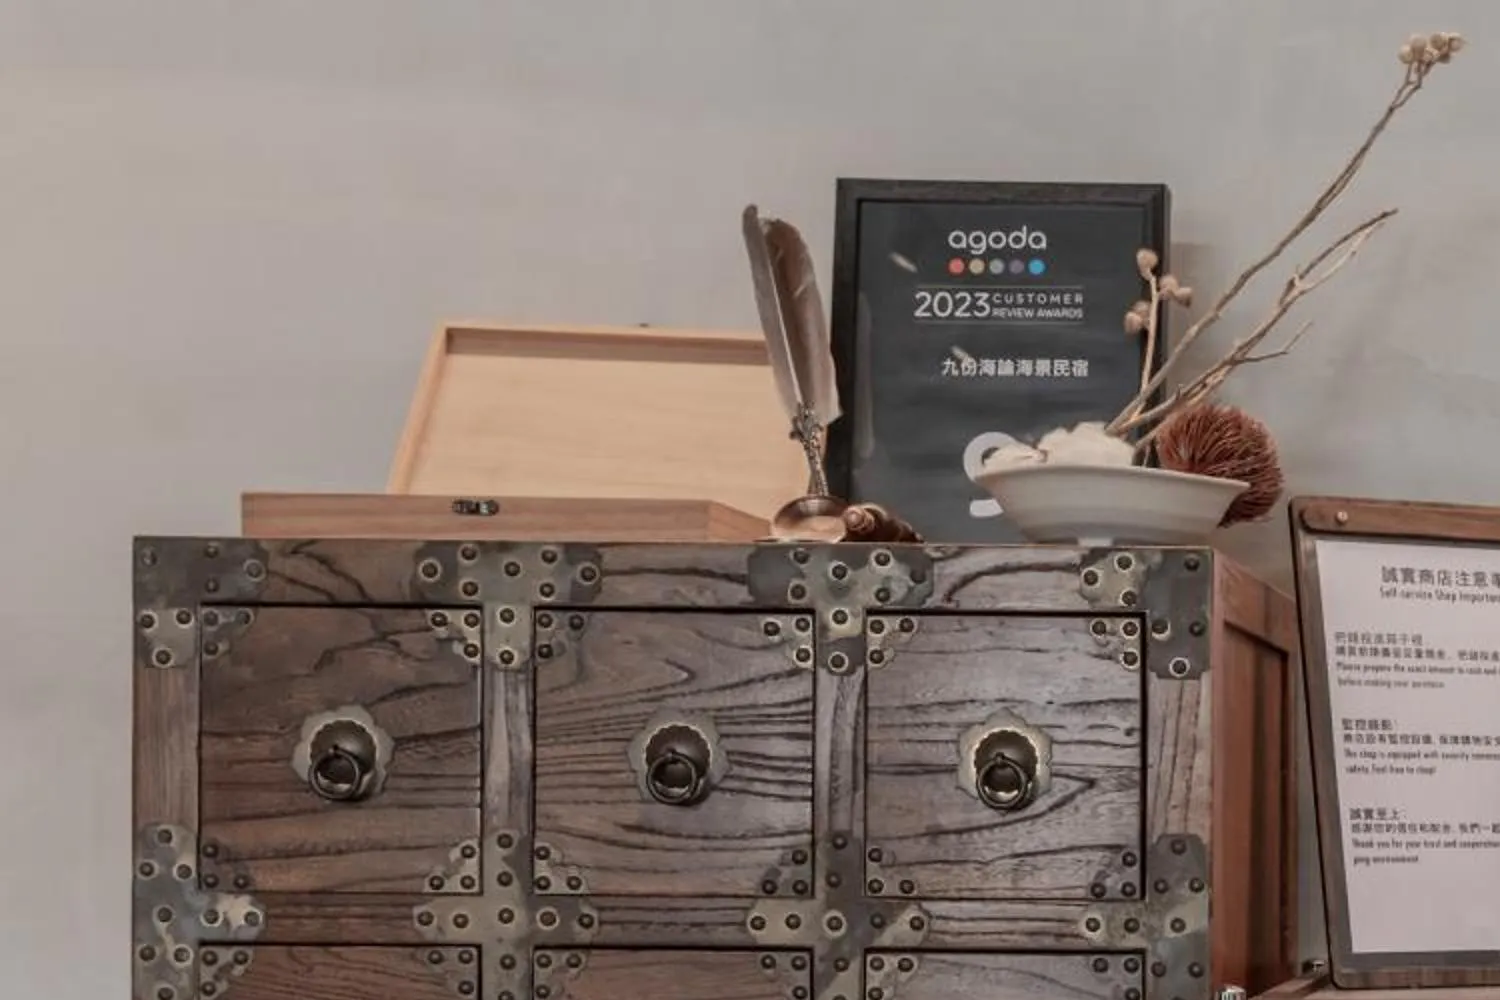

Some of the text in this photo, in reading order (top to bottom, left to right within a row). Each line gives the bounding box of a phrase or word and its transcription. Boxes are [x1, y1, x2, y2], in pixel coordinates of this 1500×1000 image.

[948, 225, 1047, 255] agoda
[914, 291, 1084, 318] 2023 CUSTOMER
[991, 307, 1084, 319] REVIEW AWARDS
